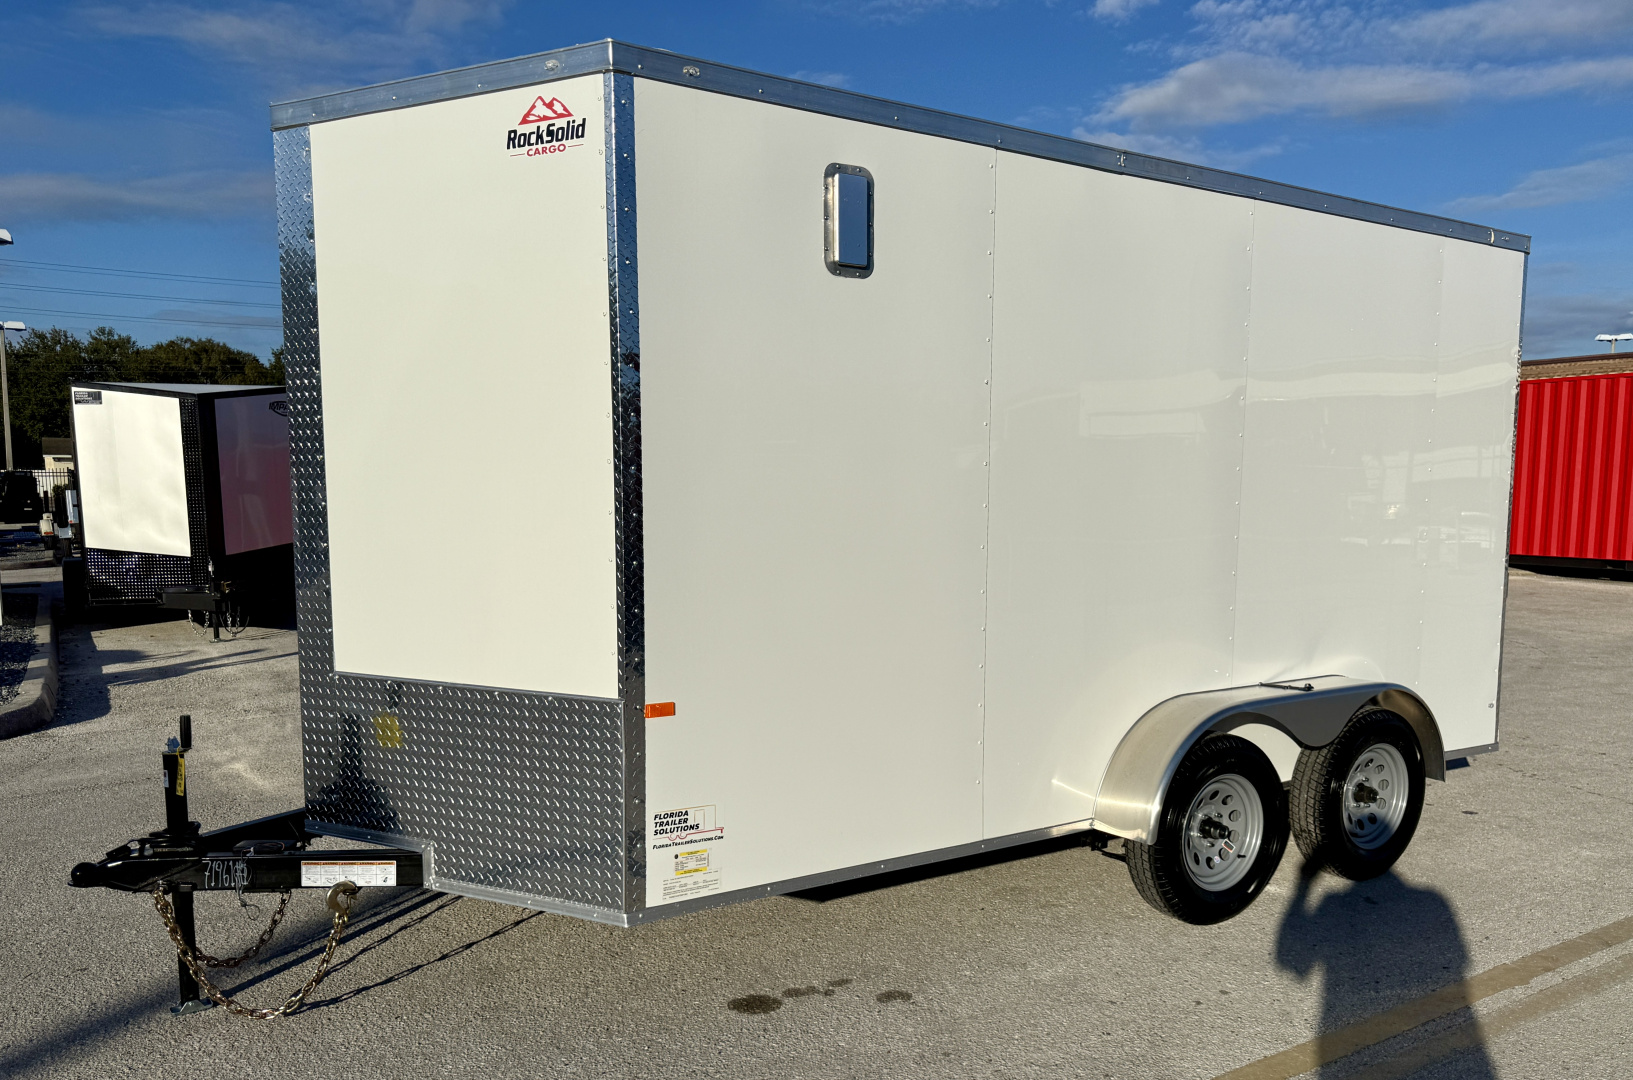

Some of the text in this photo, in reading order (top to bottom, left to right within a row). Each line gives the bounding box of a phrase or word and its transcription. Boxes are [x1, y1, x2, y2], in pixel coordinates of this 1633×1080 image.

[507, 118, 586, 150] RockSolid
[526, 143, 567, 157] CARGO
[653, 810, 689, 821] FLORIDA
[654, 817, 689, 828] TRAILER
[653, 823, 700, 836] SOLUTIONS
